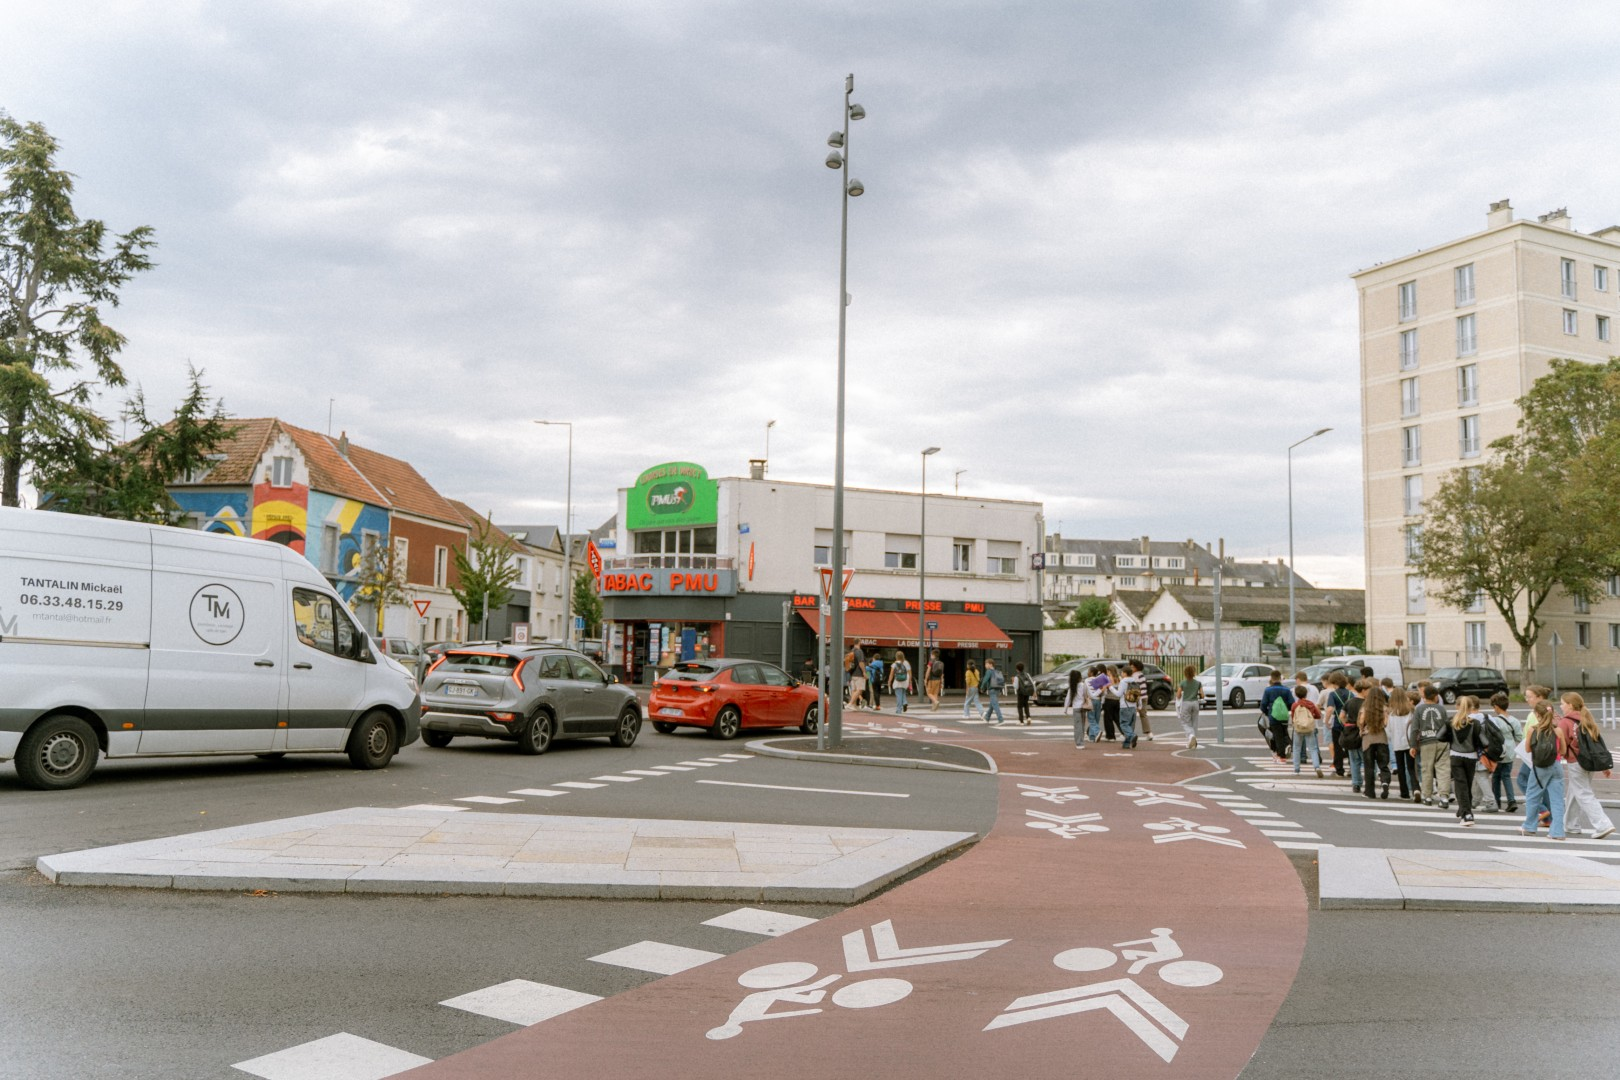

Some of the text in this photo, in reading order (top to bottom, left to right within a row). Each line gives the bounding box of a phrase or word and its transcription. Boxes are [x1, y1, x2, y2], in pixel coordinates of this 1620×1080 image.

[20, 577, 123, 594] TANTALIN Mickaël
[603, 573, 719, 592] TABAC PMU
[20, 593, 123, 611] 06.33.48.15.29
[793, 595, 816, 606] BAR
[905, 600, 942, 611] PRSSE
[964, 603, 985, 612] PMU
